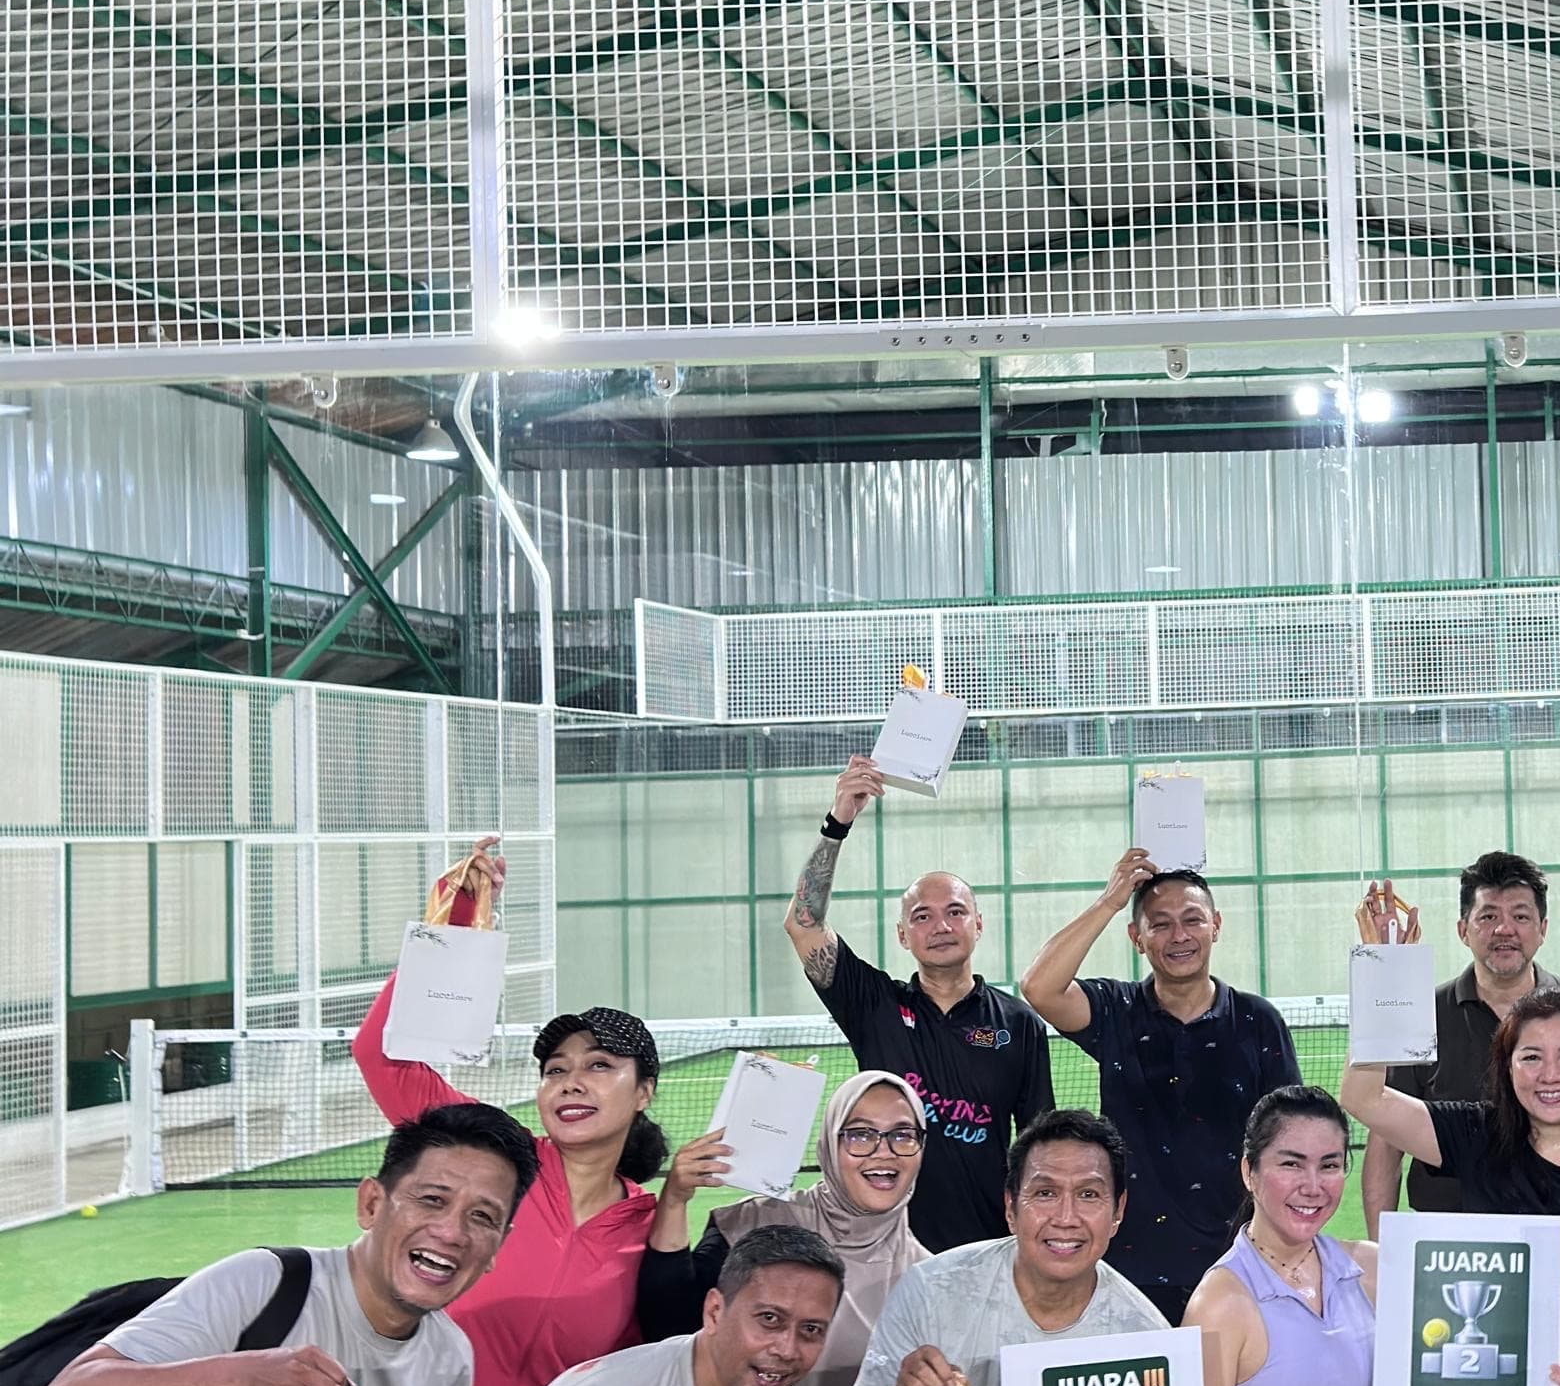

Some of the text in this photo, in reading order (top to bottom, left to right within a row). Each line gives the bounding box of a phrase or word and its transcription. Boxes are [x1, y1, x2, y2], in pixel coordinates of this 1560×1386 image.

[943, 1123, 988, 1144] CLUB
[1424, 1251, 1524, 1273] JUARA II
[1459, 1349, 1480, 1373] 2
